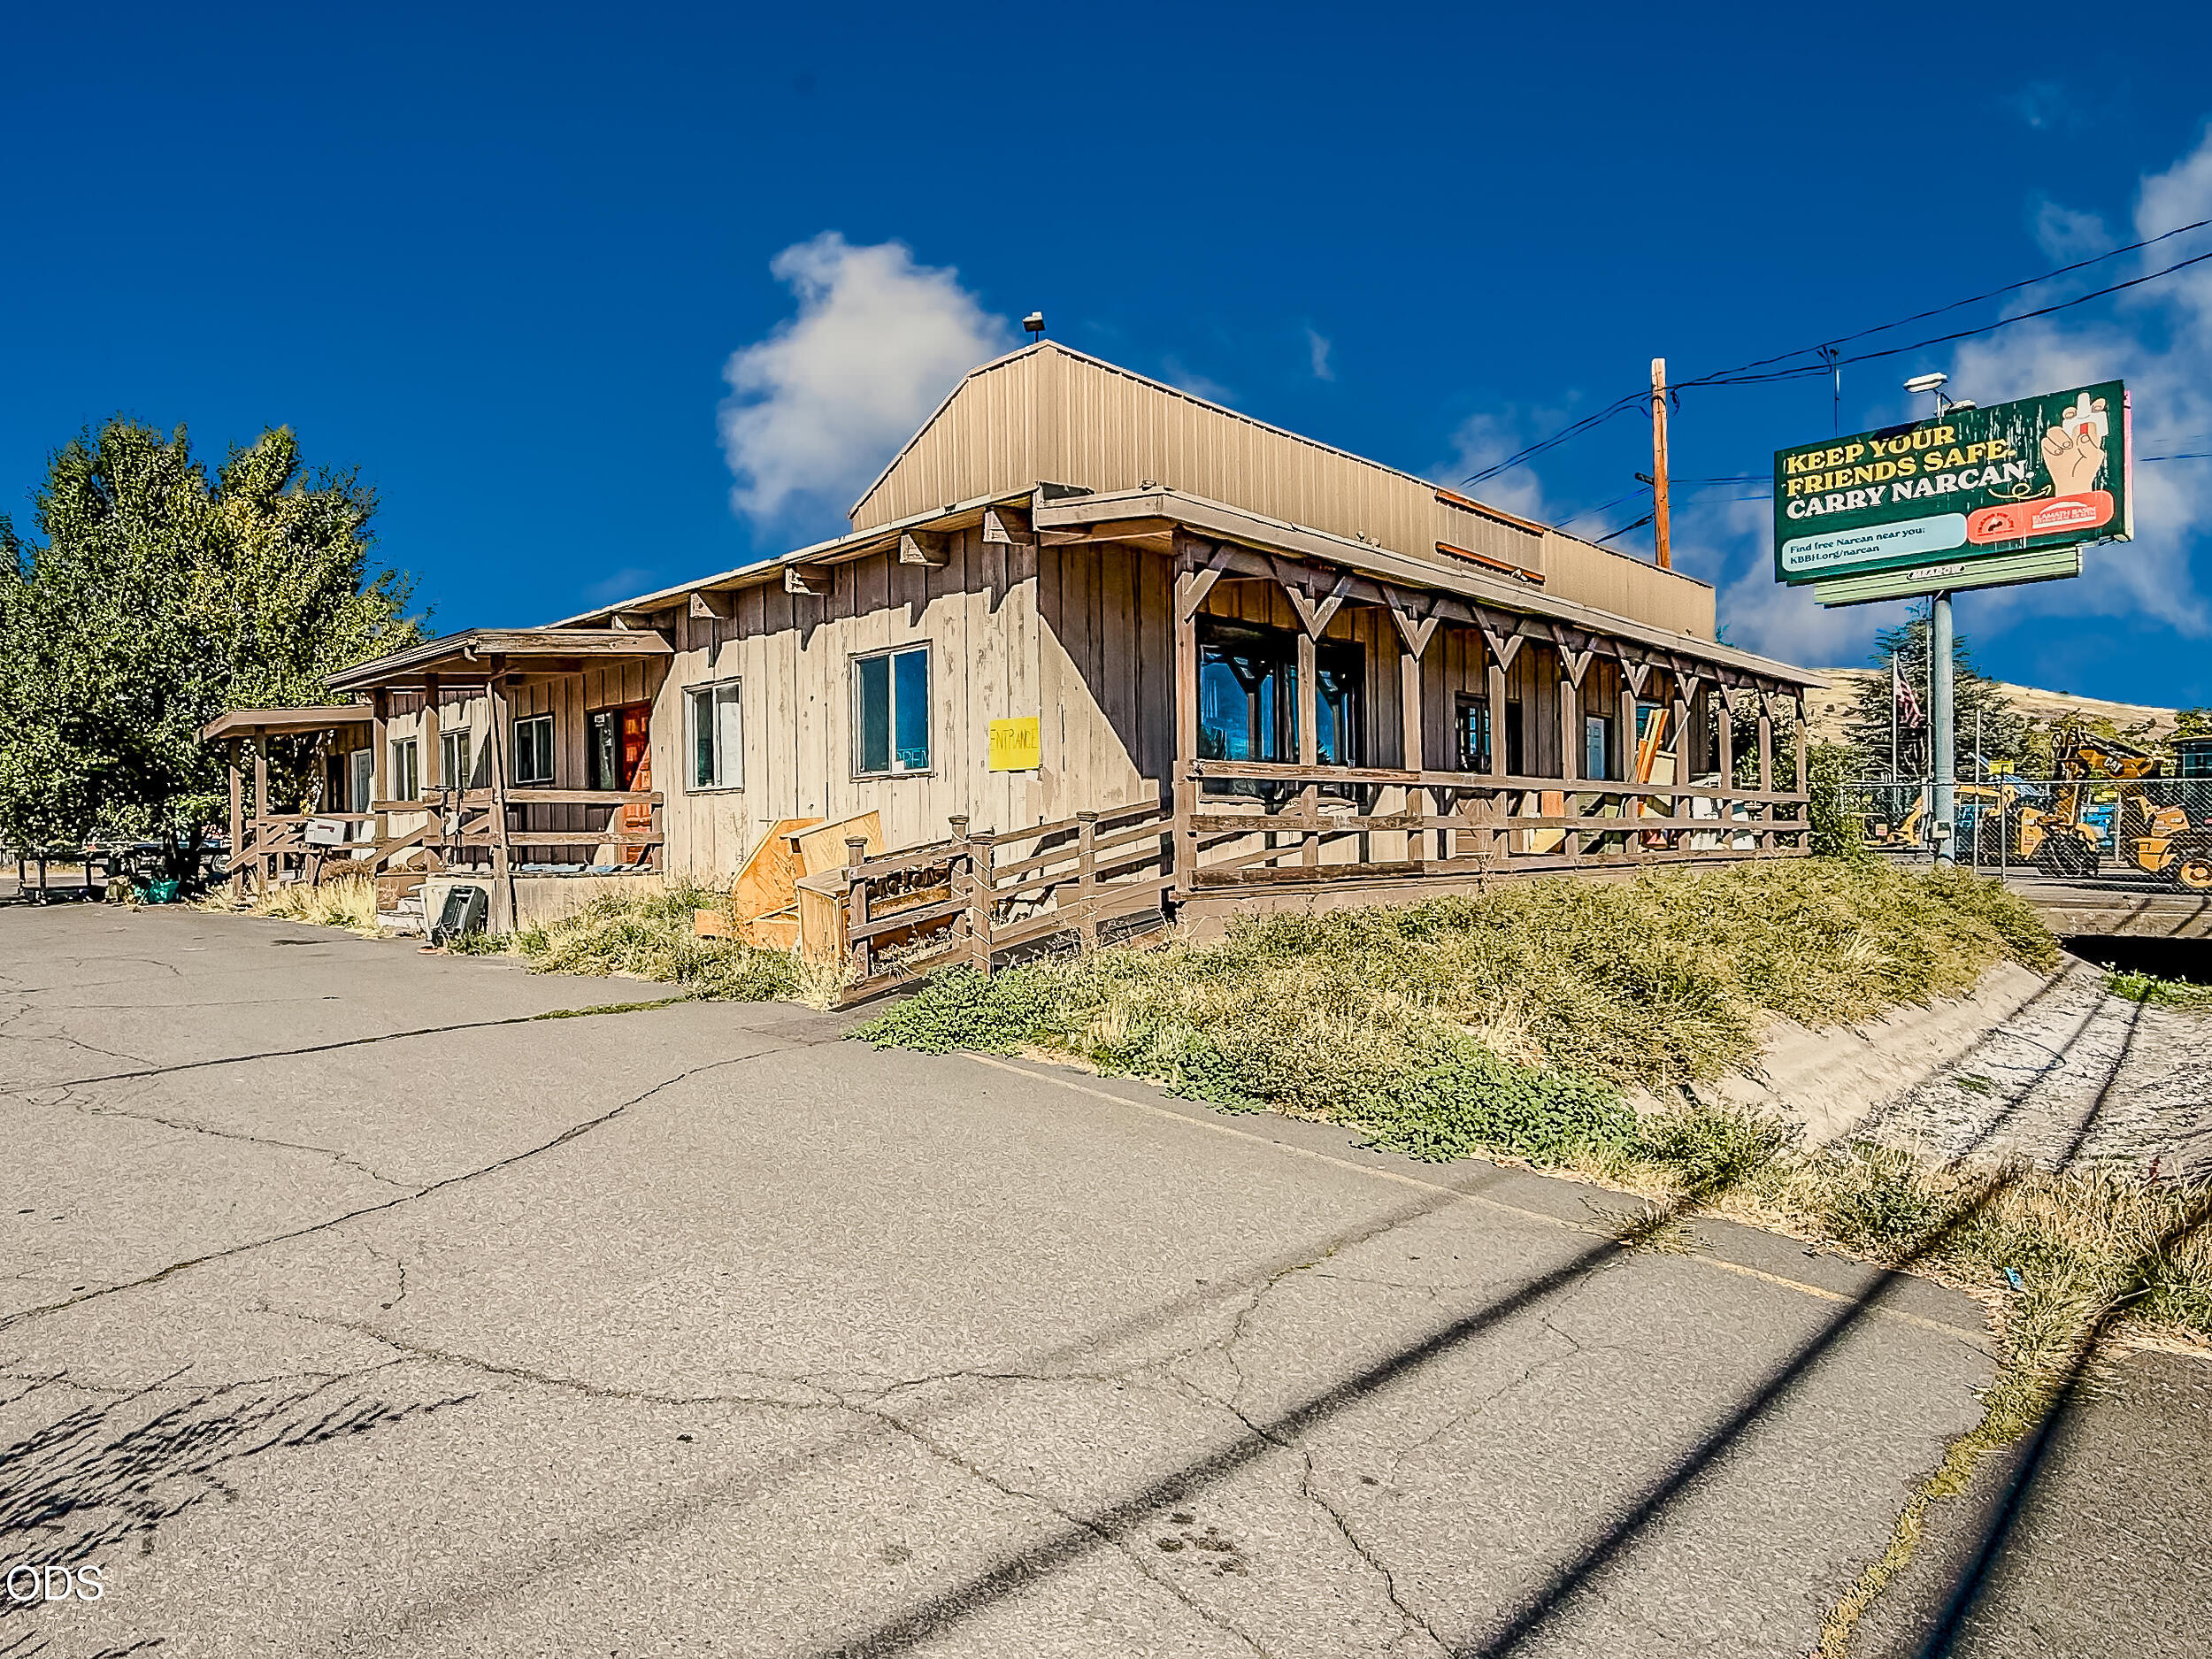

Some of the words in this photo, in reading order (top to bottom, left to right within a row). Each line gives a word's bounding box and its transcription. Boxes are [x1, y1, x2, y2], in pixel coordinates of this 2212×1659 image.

[1786, 443, 1865, 474] KEEP
[1868, 426, 1956, 458] YOUR
[1786, 456, 1917, 497] FRIENDS
[1923, 438, 2017, 472] SAFE.
[1786, 485, 1886, 519] CARRY
[1892, 459, 2035, 503] NARCAN.
[1790, 542, 1812, 554] Find
[1814, 541, 1834, 549] free
[1836, 535, 1874, 547] Narcan
[1876, 530, 1901, 541] near
[1901, 527, 1926, 538] you:
[989, 728, 1038, 751] ENTRANCE
[2103, 757, 2124, 772] CAT
